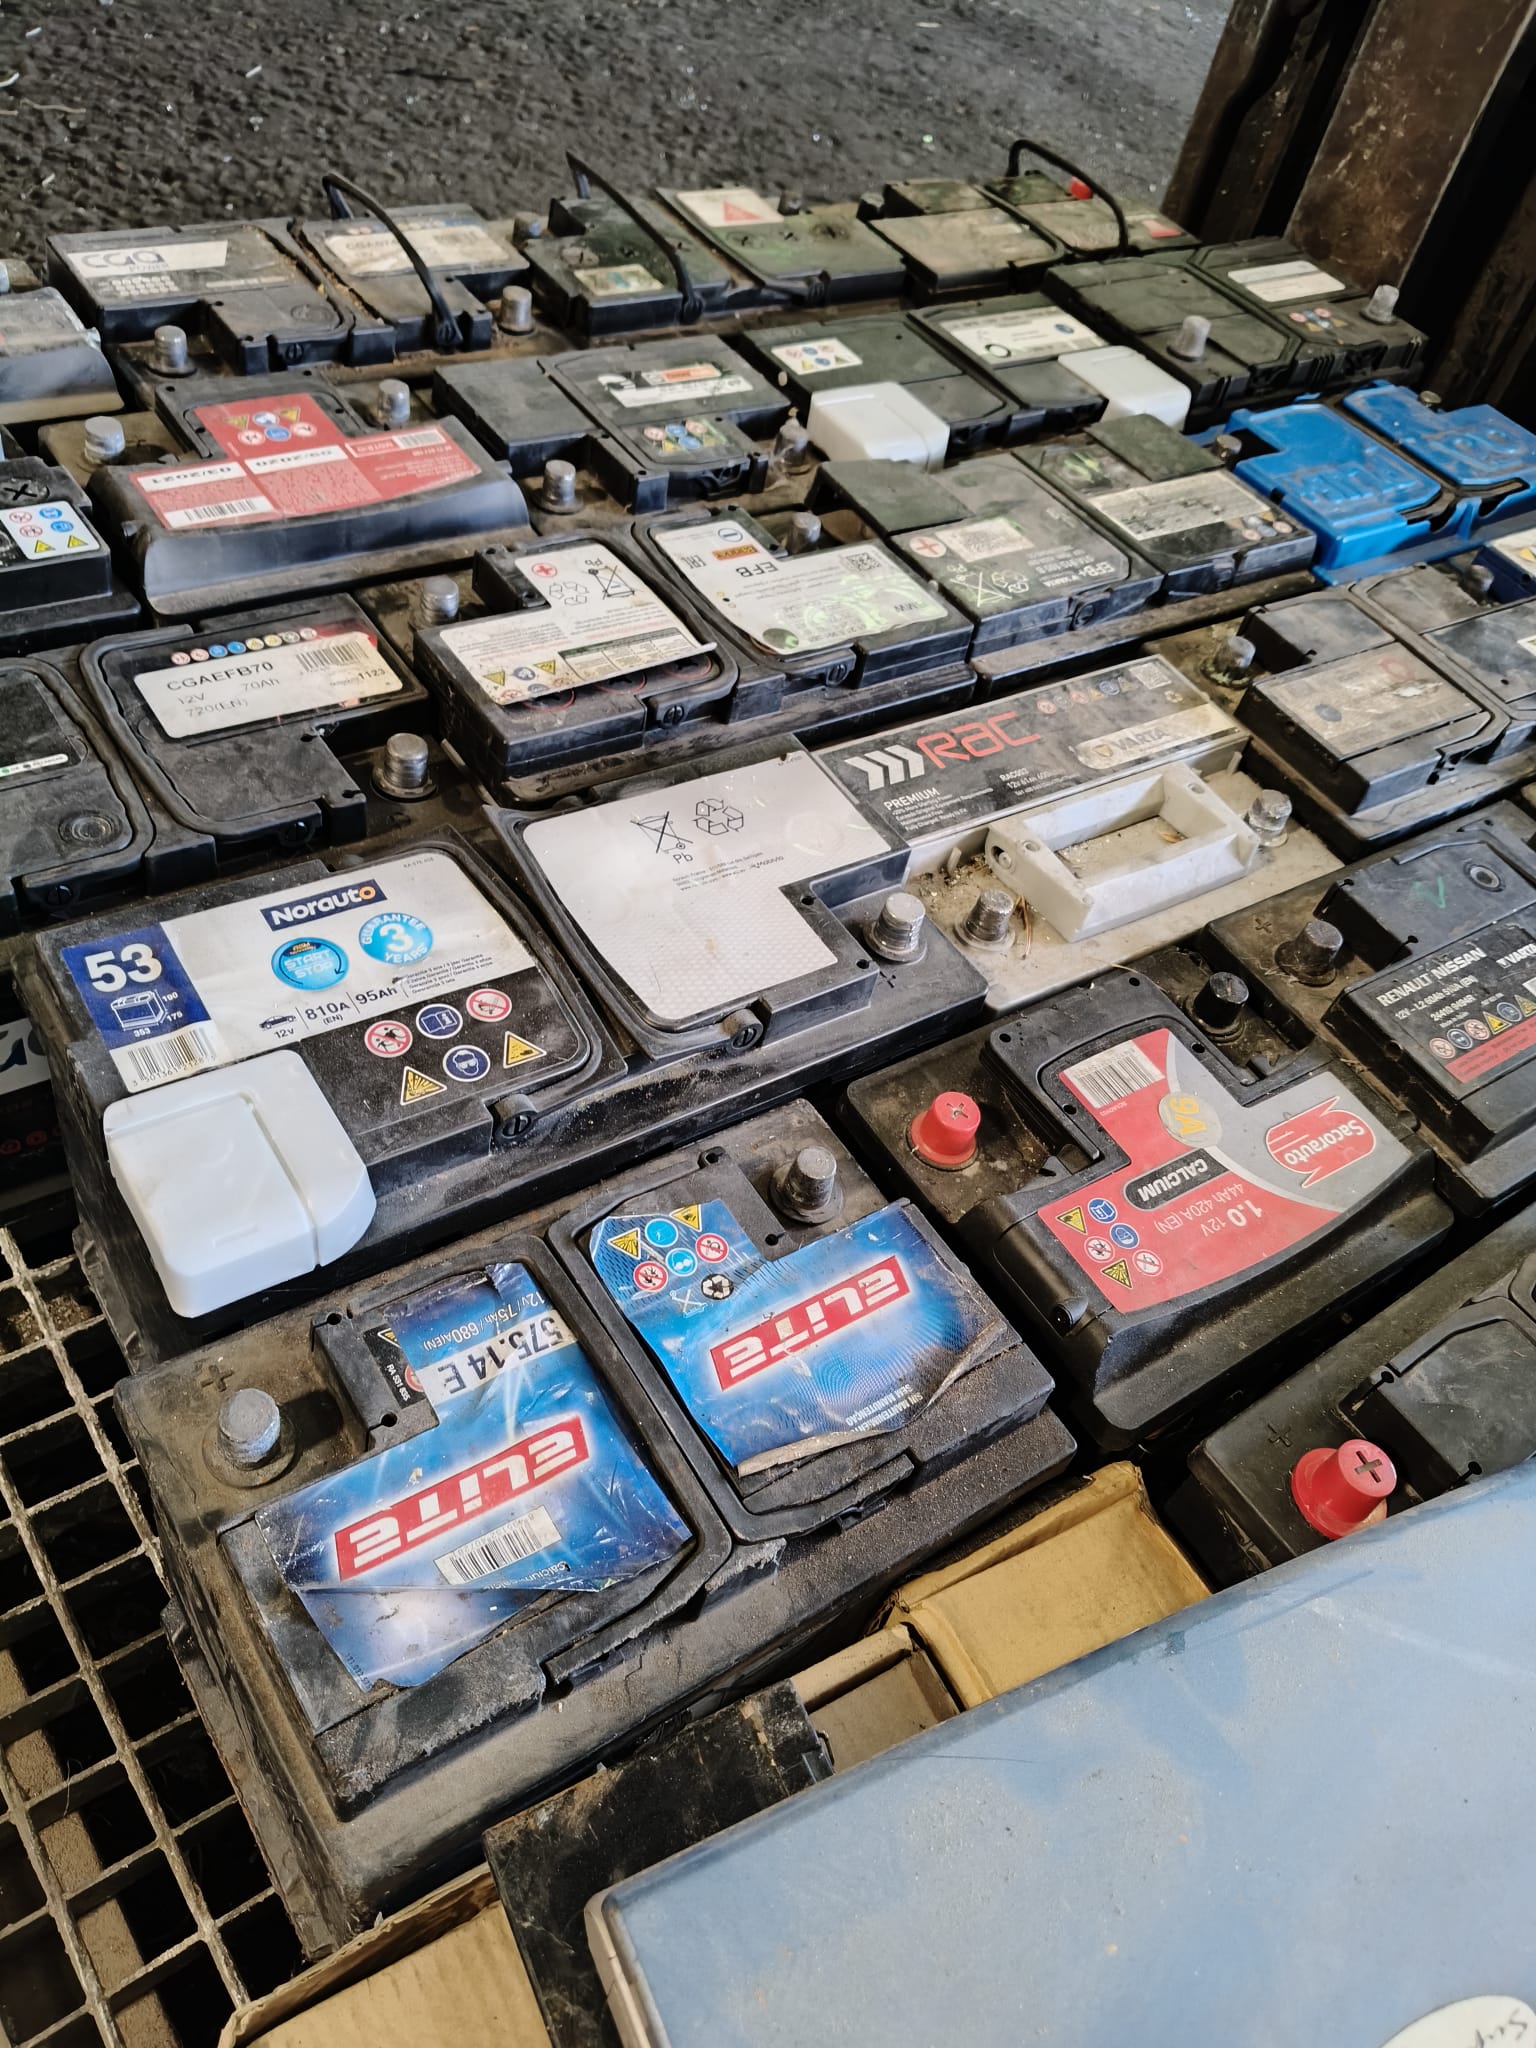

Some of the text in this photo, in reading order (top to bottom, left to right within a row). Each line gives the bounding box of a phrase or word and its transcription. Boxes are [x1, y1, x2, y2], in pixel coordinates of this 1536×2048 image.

[736, 561, 778, 579] EFB
[166, 661, 274, 692] CGAEFB70
[1111, 726, 1169, 752] VARTA
[883, 787, 940, 811] PREMIUM
[673, 852, 694, 864] Pb
[270, 885, 376, 926] Norauto
[361, 913, 427, 945] GUARANTEE
[379, 922, 414, 953] 3
[84, 943, 162, 993] 53
[284, 950, 330, 972] START
[384, 941, 429, 965] YEARS
[1376, 947, 1487, 1007] RENAULT NISSAN
[305, 1001, 350, 1020] 810A
[355, 986, 398, 1005] 95Ah
[323, 1015, 344, 1026] (EN)
[1284, 1119, 1365, 1166] Sacorauto
[1137, 1158, 1209, 1202] CALCIUM
[1154, 1183, 1245, 1235] 44Ah 420A (EN)
[1200, 1200, 1264, 1237] 1.0 12V
[485, 1304, 518, 1331] 75Ah
[522, 1294, 546, 1313] 12v
[423, 1321, 480, 1352] 680A(EN)
[437, 1315, 563, 1395] 575.14 E
[894, 1384, 913, 1398] SEM
